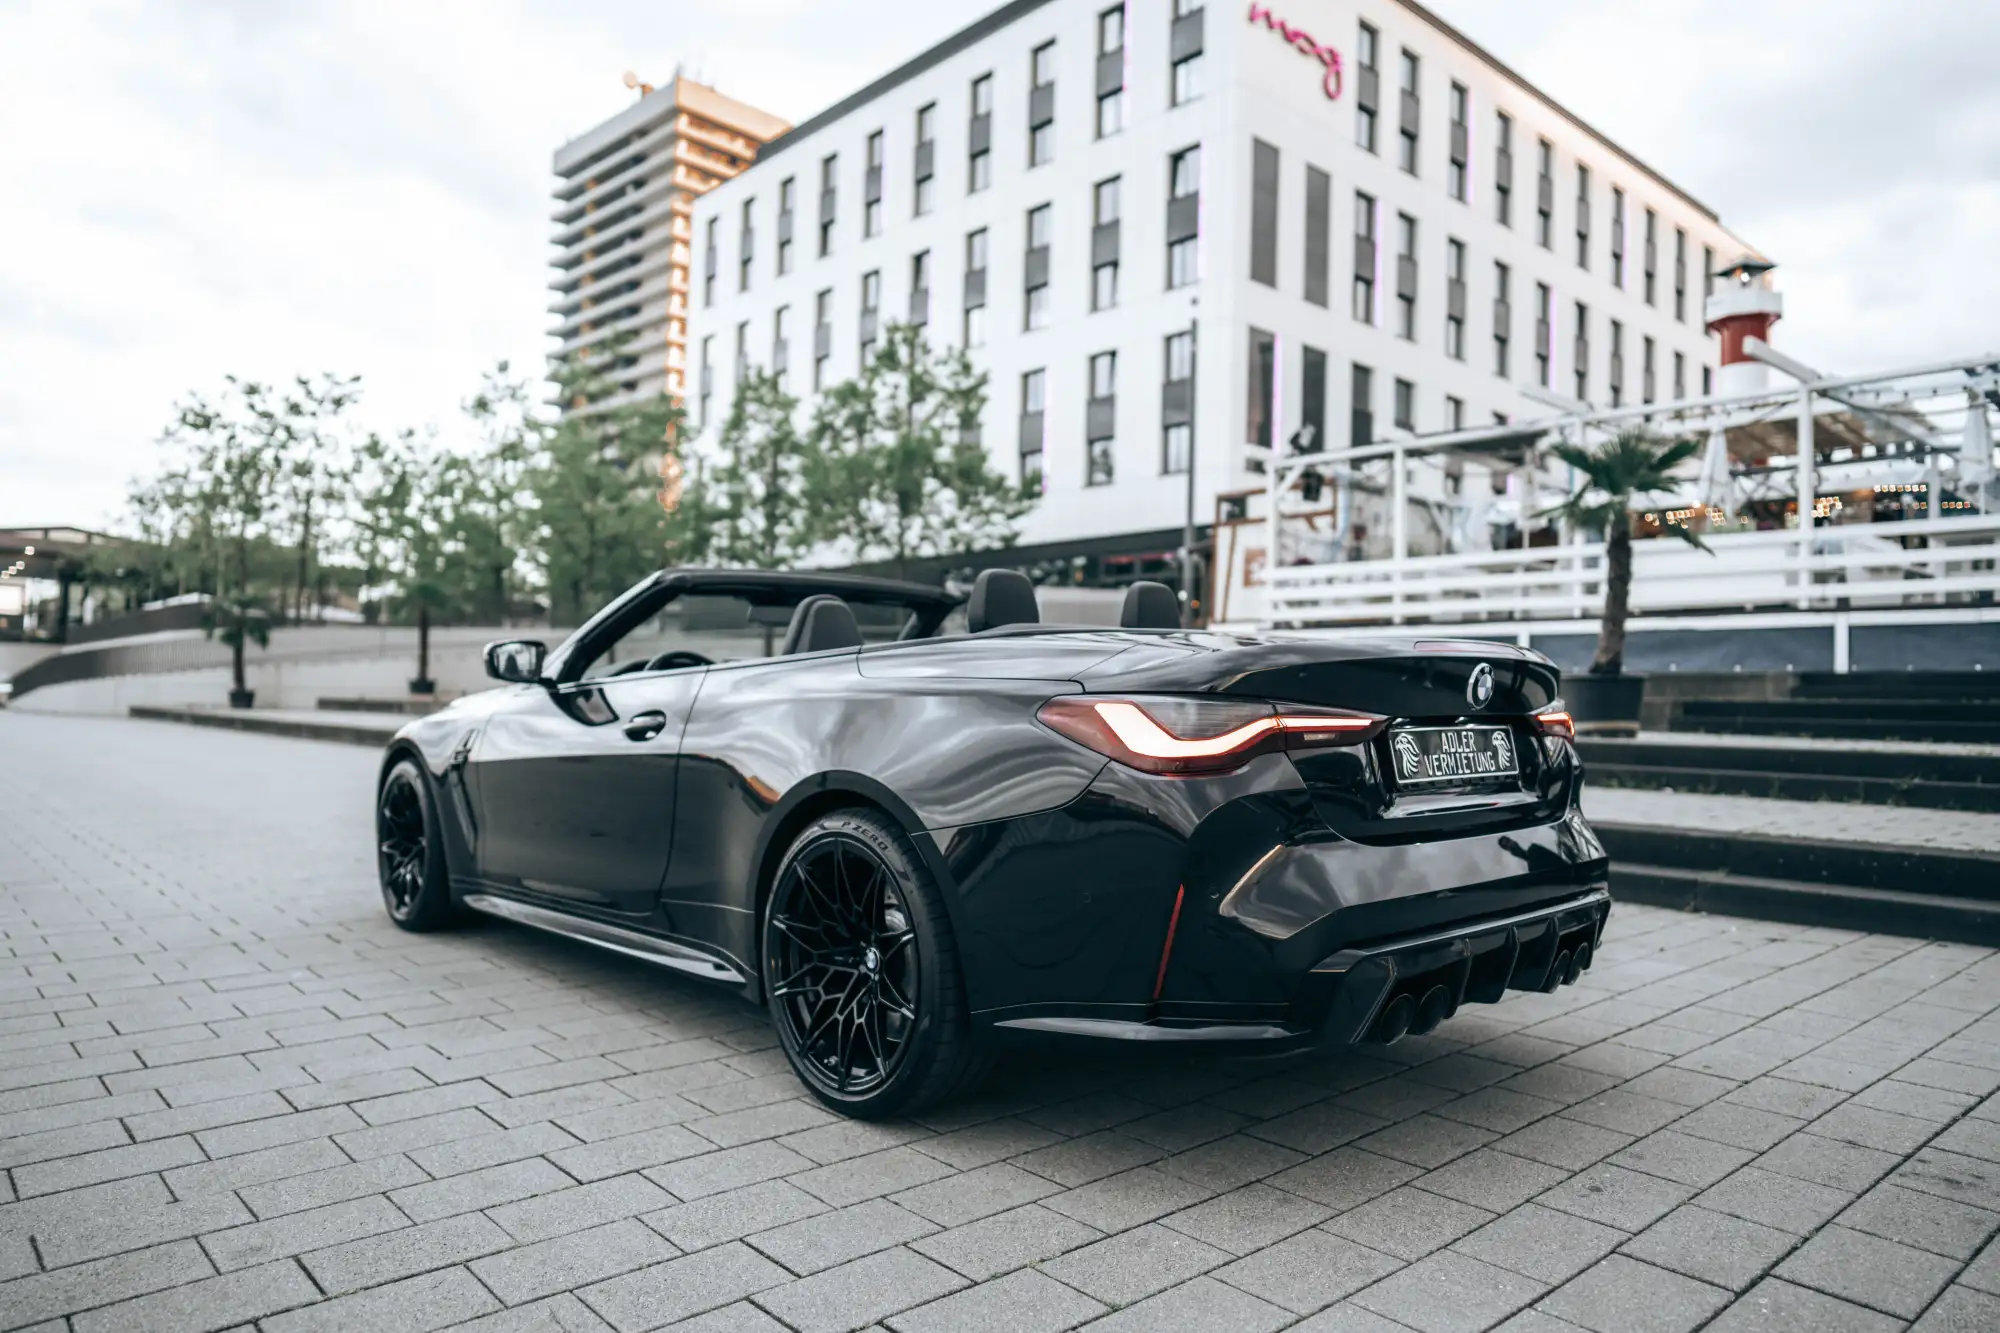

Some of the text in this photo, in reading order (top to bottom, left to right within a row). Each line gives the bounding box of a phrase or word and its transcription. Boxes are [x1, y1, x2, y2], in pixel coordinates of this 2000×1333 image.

[1442, 731, 1477, 752] ADLER
[1424, 752, 1495, 776] VERMIETUNG
[852, 824, 889, 851] ZERO
